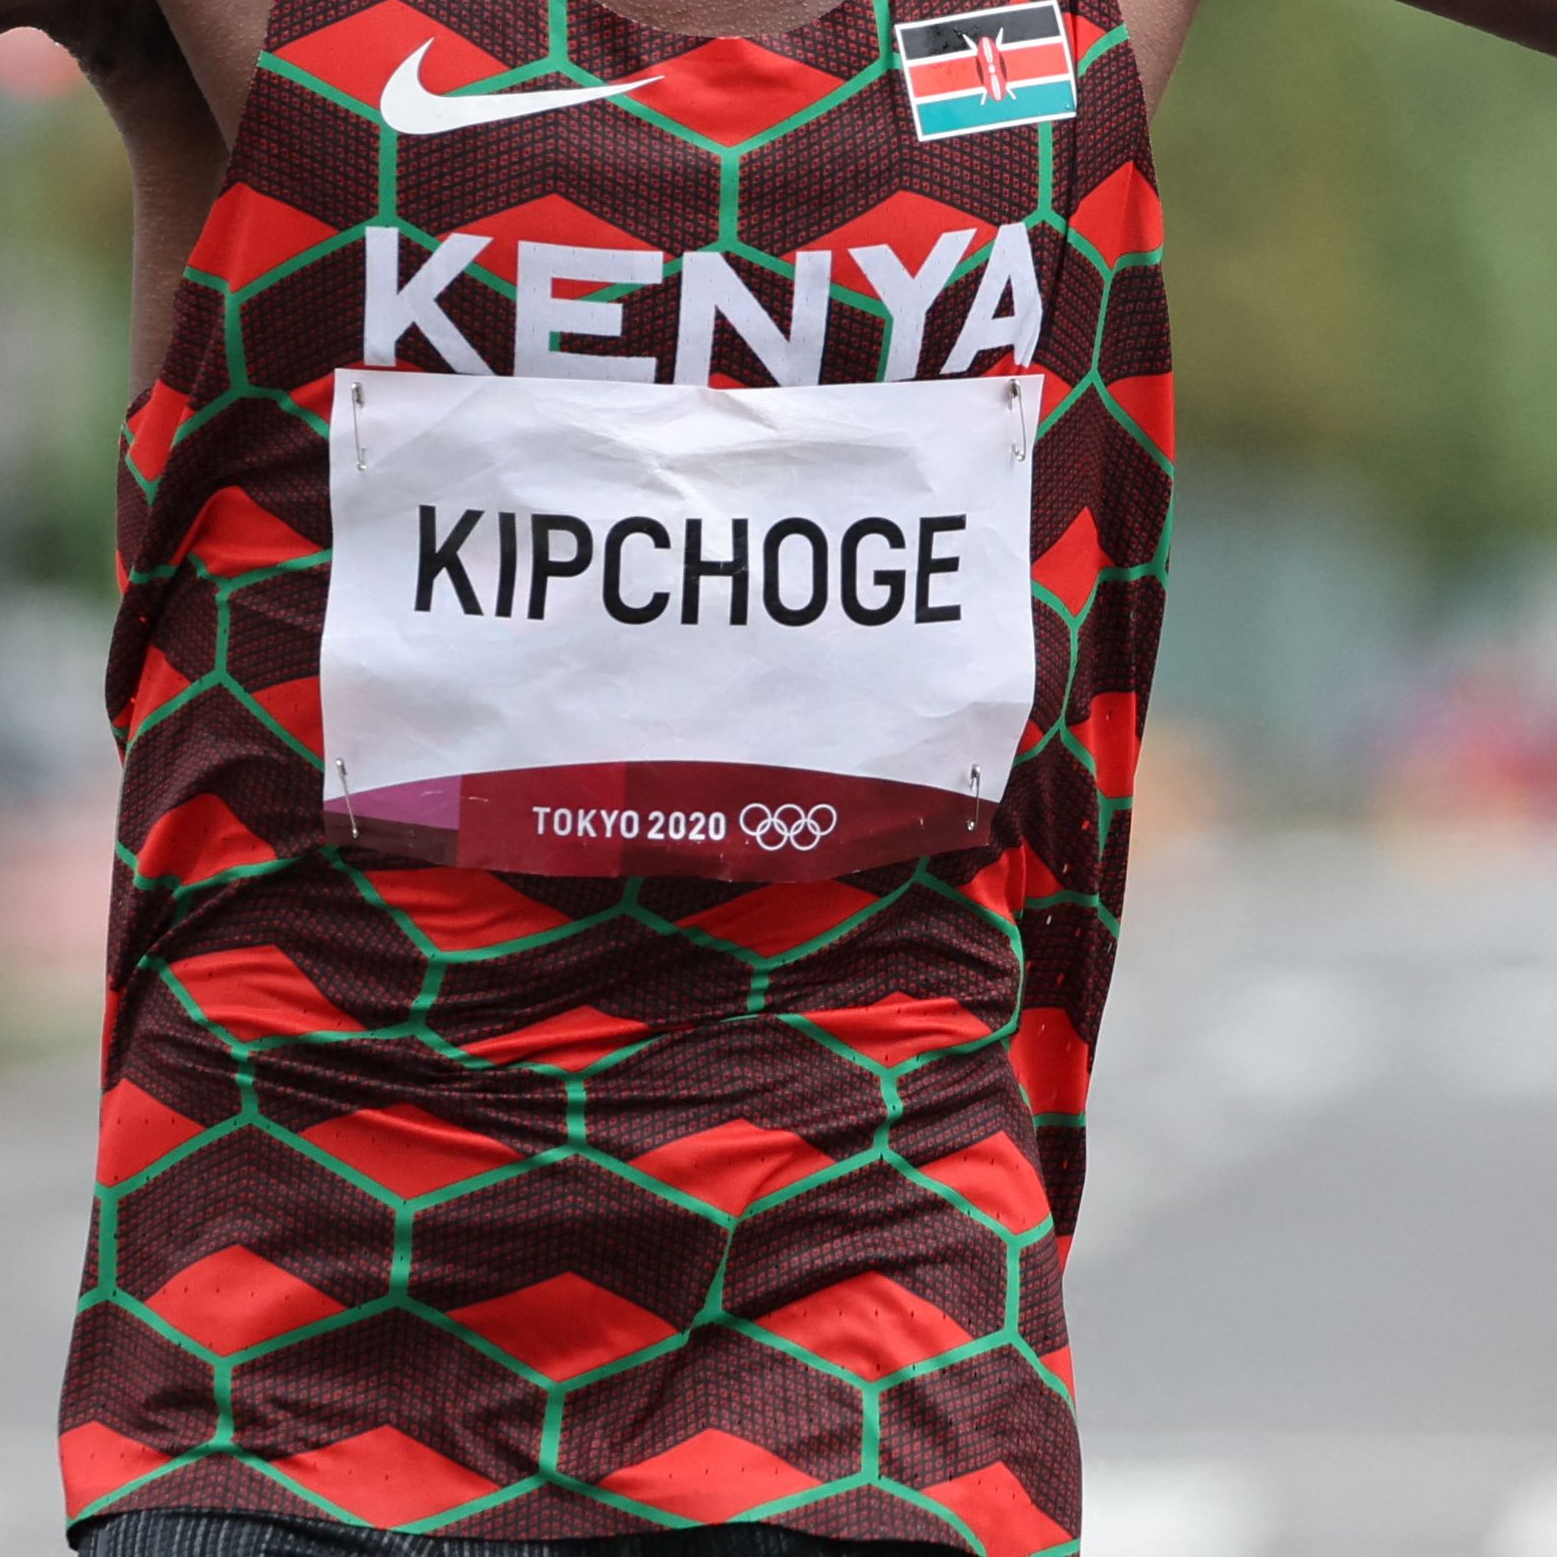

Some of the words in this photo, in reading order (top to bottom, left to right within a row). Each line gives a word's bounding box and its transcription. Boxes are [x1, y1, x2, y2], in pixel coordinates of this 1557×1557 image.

[363, 222, 1043, 387] KENYA
[413, 503, 968, 628] KIPCHOGE
[531, 805, 641, 839] TOKYO
[647, 810, 727, 841] 2020
